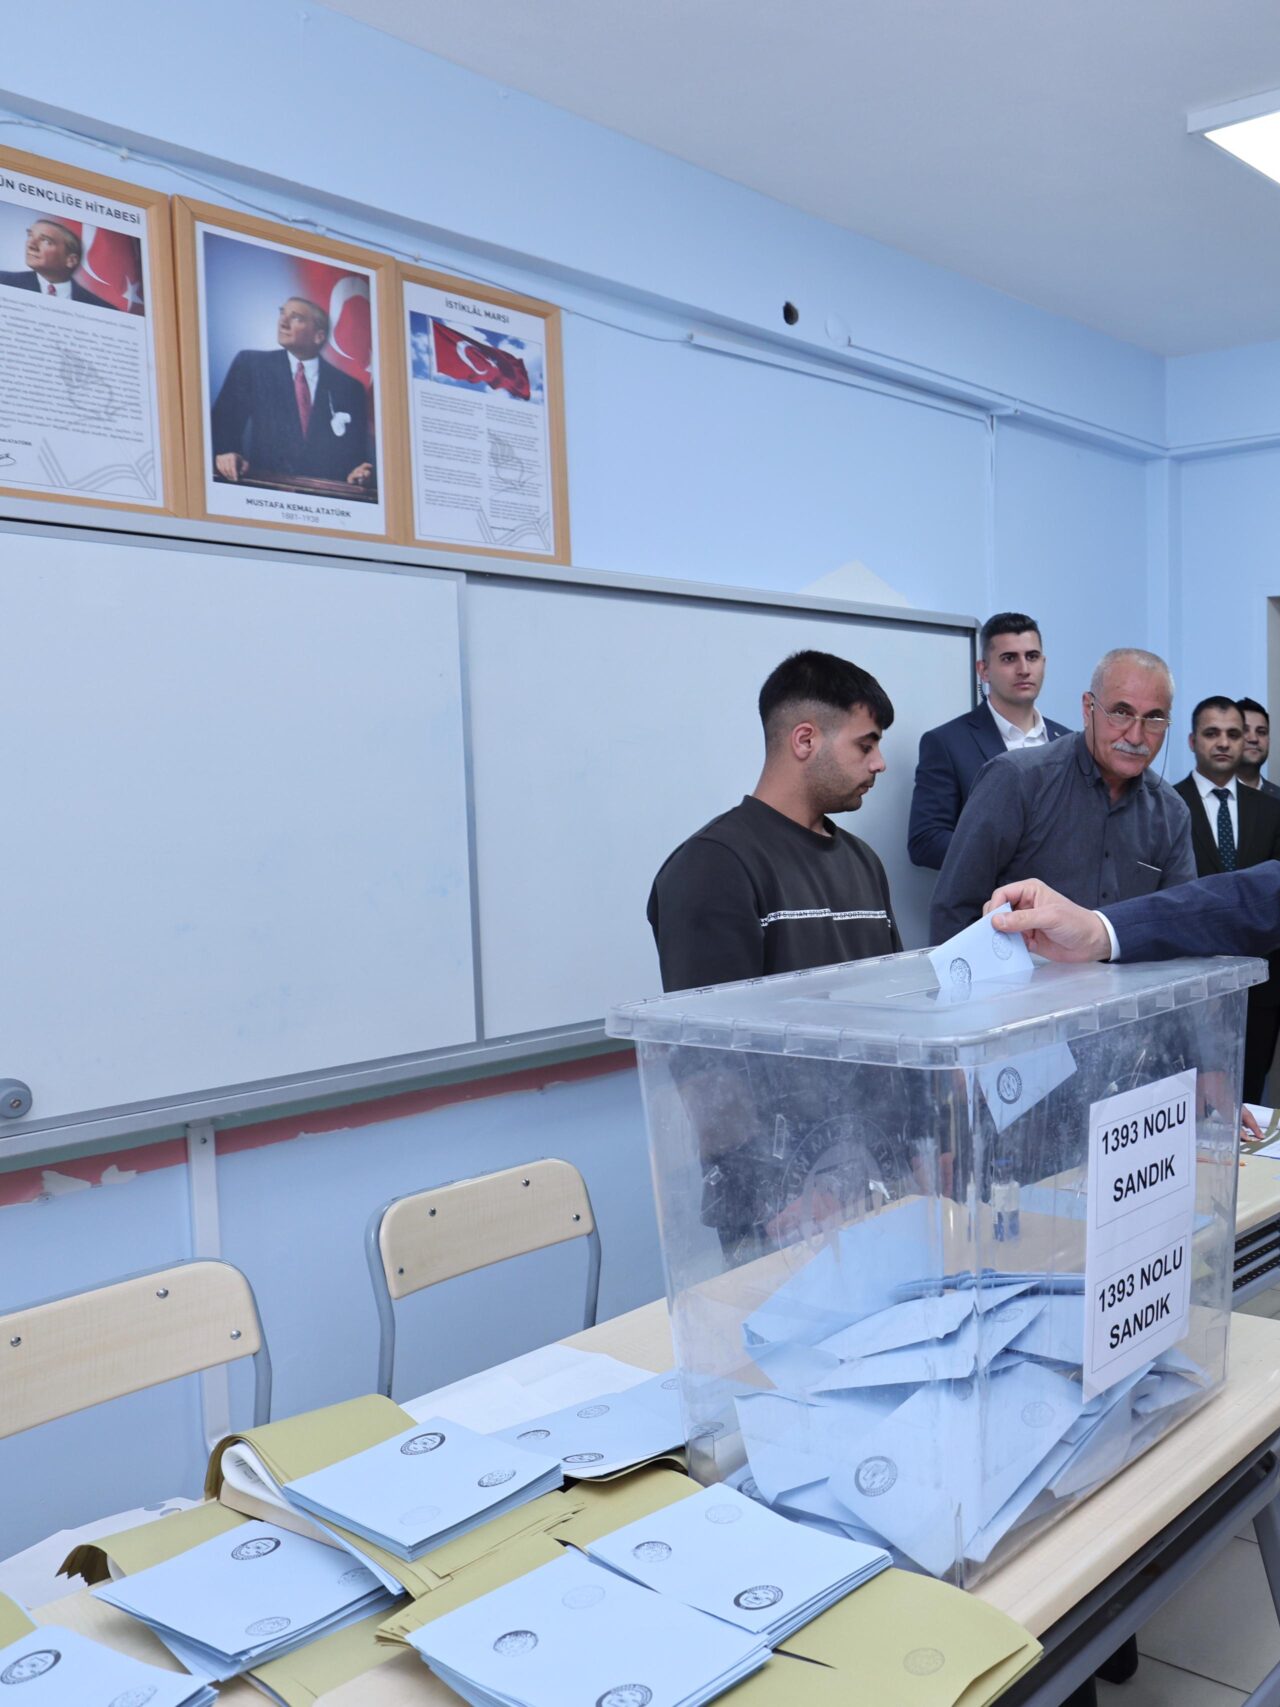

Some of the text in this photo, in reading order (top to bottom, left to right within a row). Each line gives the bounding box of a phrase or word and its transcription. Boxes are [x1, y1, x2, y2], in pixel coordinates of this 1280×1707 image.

[18, 182, 82, 209] GENÇLİĞE
[85, 201, 141, 224] HİTABESİ
[246, 498, 352, 518] MUSTAFA KEMAL ATATÜRK
[1102, 1101, 1186, 1155] 1393 NOLU
[1113, 1154, 1175, 1202] SANDIK
[1099, 1246, 1183, 1312] 1393 NOLU
[1109, 1292, 1171, 1349] SANDIK
